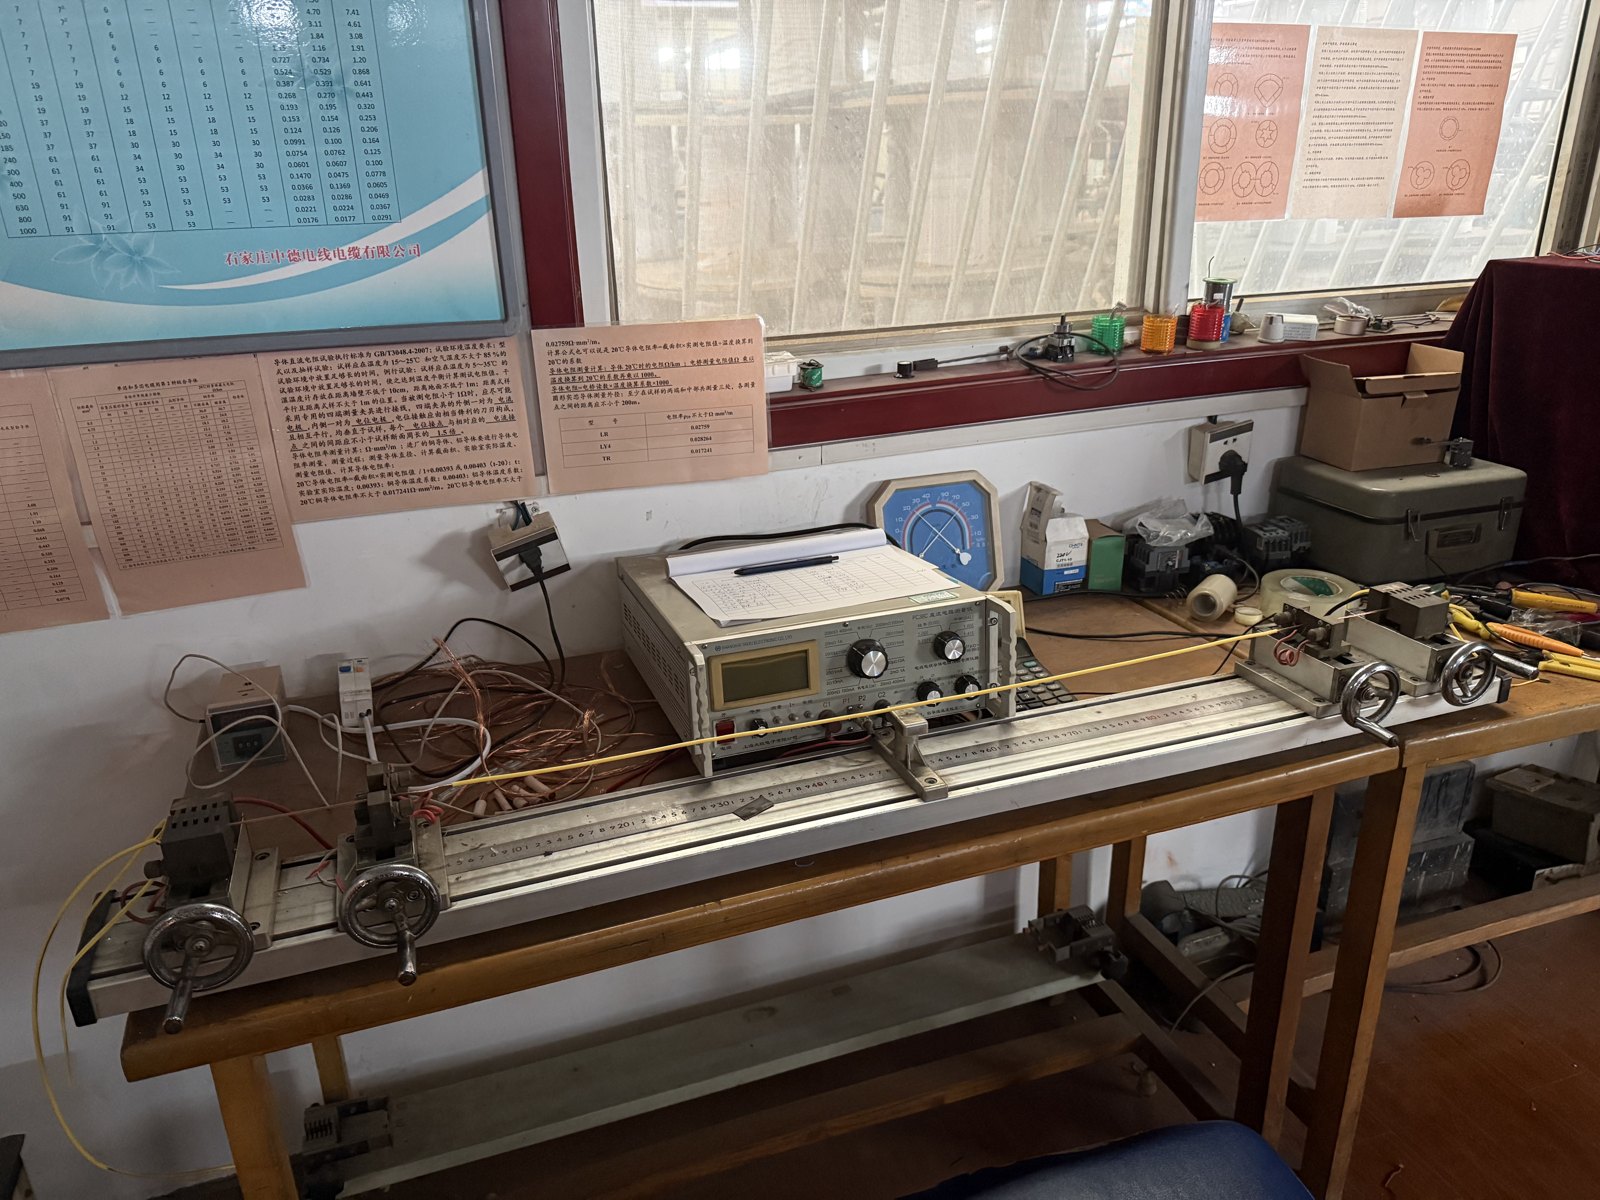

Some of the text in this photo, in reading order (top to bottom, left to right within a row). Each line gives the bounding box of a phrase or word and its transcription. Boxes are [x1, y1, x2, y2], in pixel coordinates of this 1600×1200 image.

[305, 8, 361, 16] 4.70 7.41
[307, 20, 362, 28] 3.11 4.61
[310, 32, 364, 40] 1.84 3.08
[311, 44, 366, 52] 1.16 1.91
[271, 55, 367, 64] 0.727 0.734 1.20
[273, 68, 371, 76] 0.524 0.529 0.868
[30, 79, 372, 90] 19 0.387 0.391 0.641
[34, 91, 374, 102] 19 0.268 0.270 0.443
[36, 106, 47, 115] 19
[279, 103, 299, 112] 0.193
[318, 103, 337, 111] 0.195
[39, 114, 377, 127] 37 0.153 0.154 0.253
[42, 125, 379, 139] 37 0.124 0.126 0.206
[0, 144, 15, 154] 185
[46, 143, 55, 151] 37
[283, 138, 306, 146] 0.0991
[361, 136, 380, 145] 0.164
[2, 148, 382, 165] 240 61 0.0754 0.0762 0.125
[6, 159, 384, 177] 300 61 0.0601 0.0607 0.100
[9, 170, 387, 188] 400 61 0.1470 0.0475 0.0778
[11, 181, 388, 201] 500 61 0.0366 0.1369 0.0605
[15, 204, 30, 212] 630
[292, 194, 316, 202] 0.0283
[330, 193, 353, 201] 0.0286
[17, 203, 391, 224] 800 91 0.0221 0.0224 0.0367
[19, 227, 38, 235] 1000
[296, 216, 320, 224] 0.0176
[334, 215, 356, 223] 0.0177
[371, 214, 393, 222] 0.0291
[225, 243, 421, 266] 石家庄中德电线电缆有限公司
